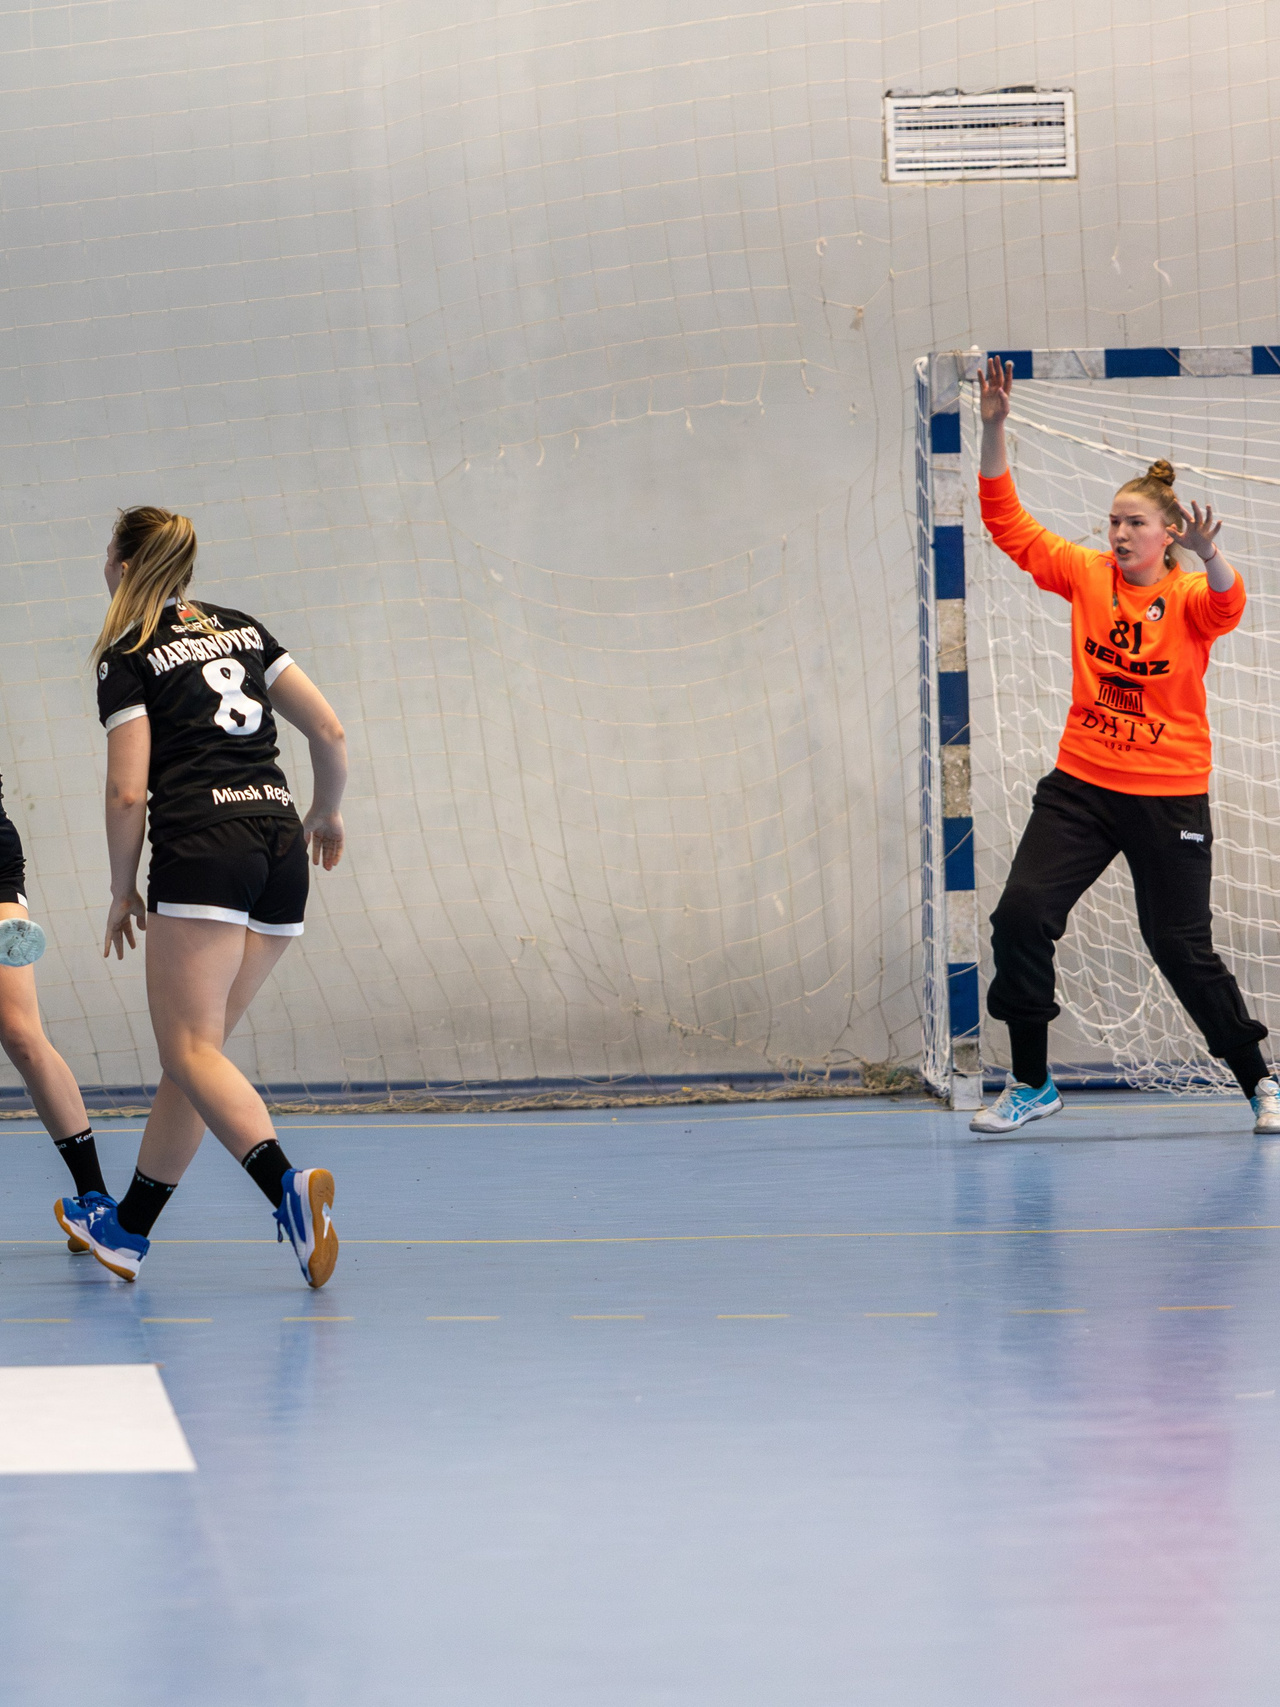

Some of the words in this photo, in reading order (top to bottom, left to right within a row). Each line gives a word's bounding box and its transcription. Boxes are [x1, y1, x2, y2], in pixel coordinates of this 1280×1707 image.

[1108, 619, 1143, 655] 81
[1083, 636, 1171, 677] BELAZ
[201, 657, 264, 736] 8
[211, 784, 263, 806] Minsk
